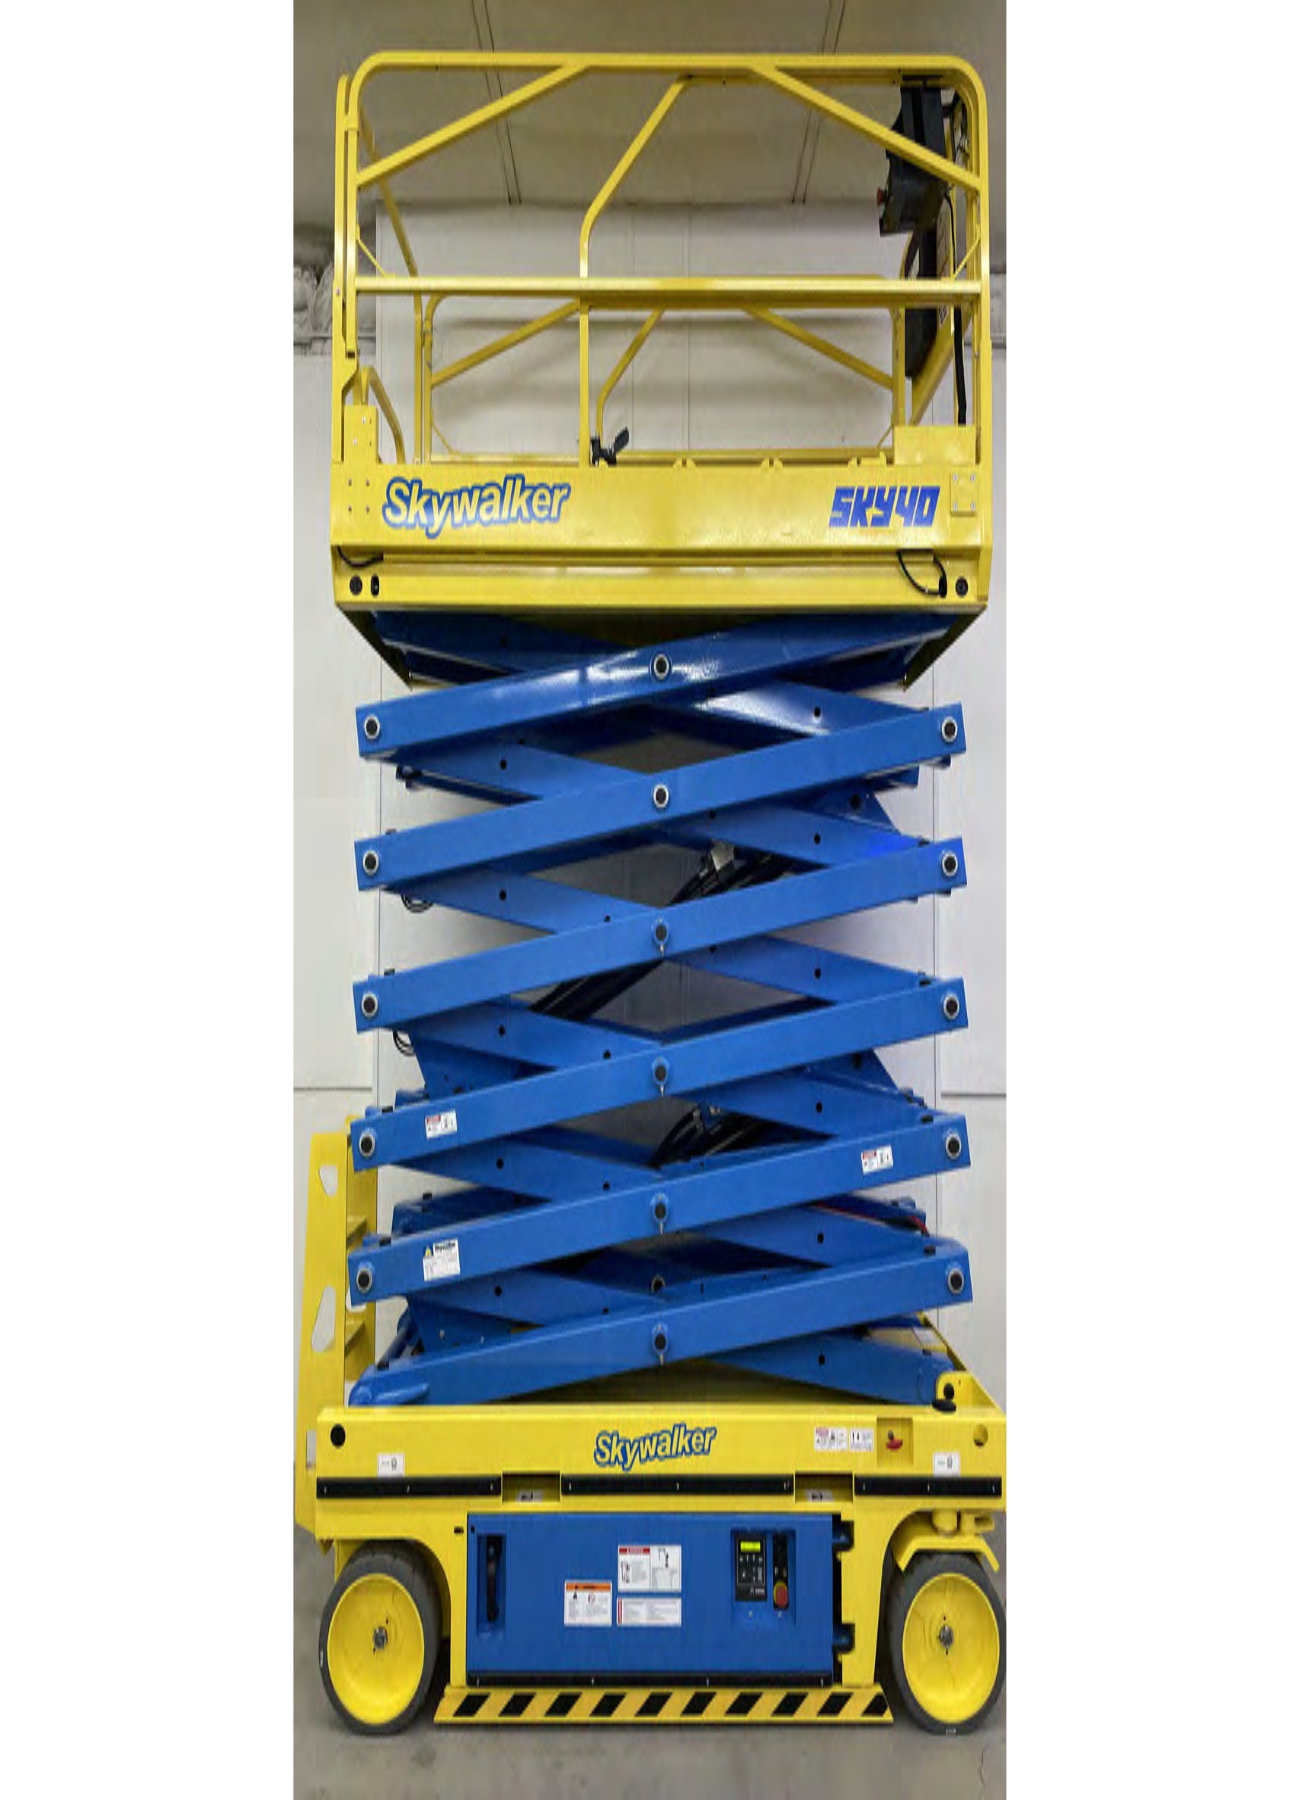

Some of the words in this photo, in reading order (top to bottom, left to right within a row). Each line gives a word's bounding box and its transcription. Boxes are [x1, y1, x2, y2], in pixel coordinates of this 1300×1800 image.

[382, 474, 571, 539] Skywalker
[829, 485, 941, 528] SKY40
[594, 1422, 717, 1472] Skywalker
